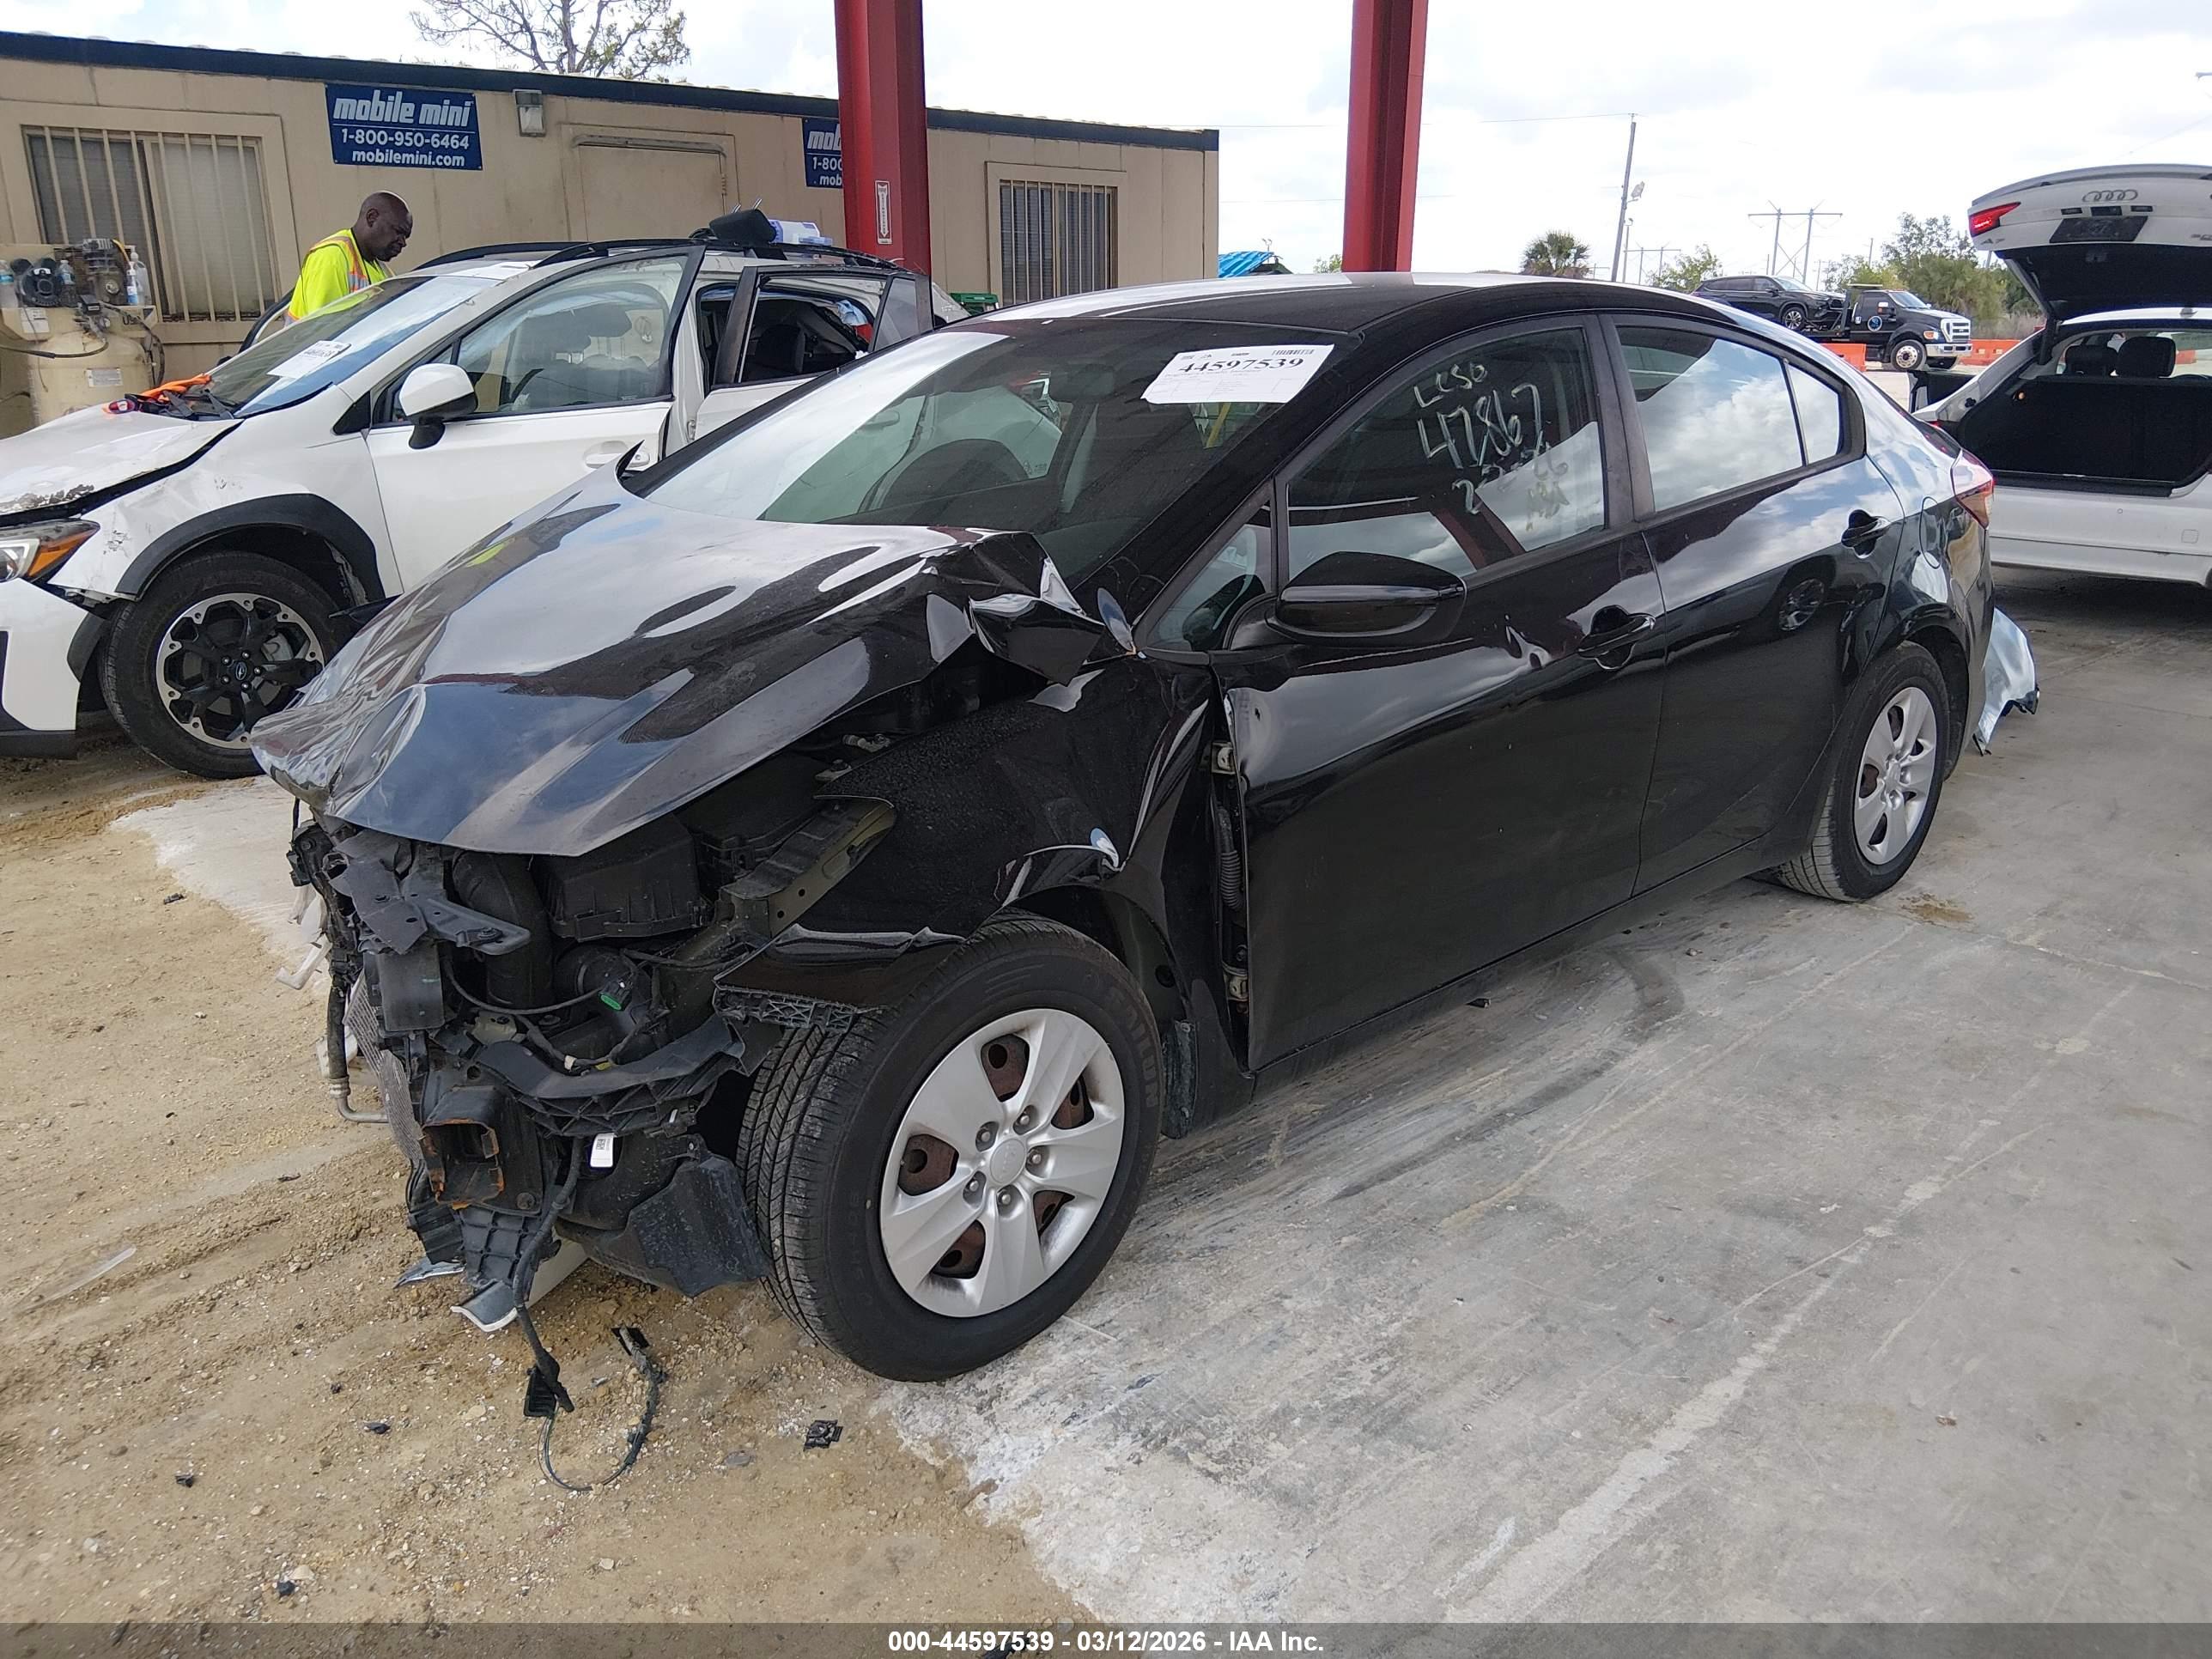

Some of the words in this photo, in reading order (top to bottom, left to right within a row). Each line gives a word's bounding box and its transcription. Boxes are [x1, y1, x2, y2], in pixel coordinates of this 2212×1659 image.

[332, 89, 415, 125] mobile
[418, 99, 471, 127] mini
[341, 128, 470, 150] 1-800-950-6464
[351, 149, 465, 167] mobilemini.com
[1179, 357, 1305, 374] 44597539
